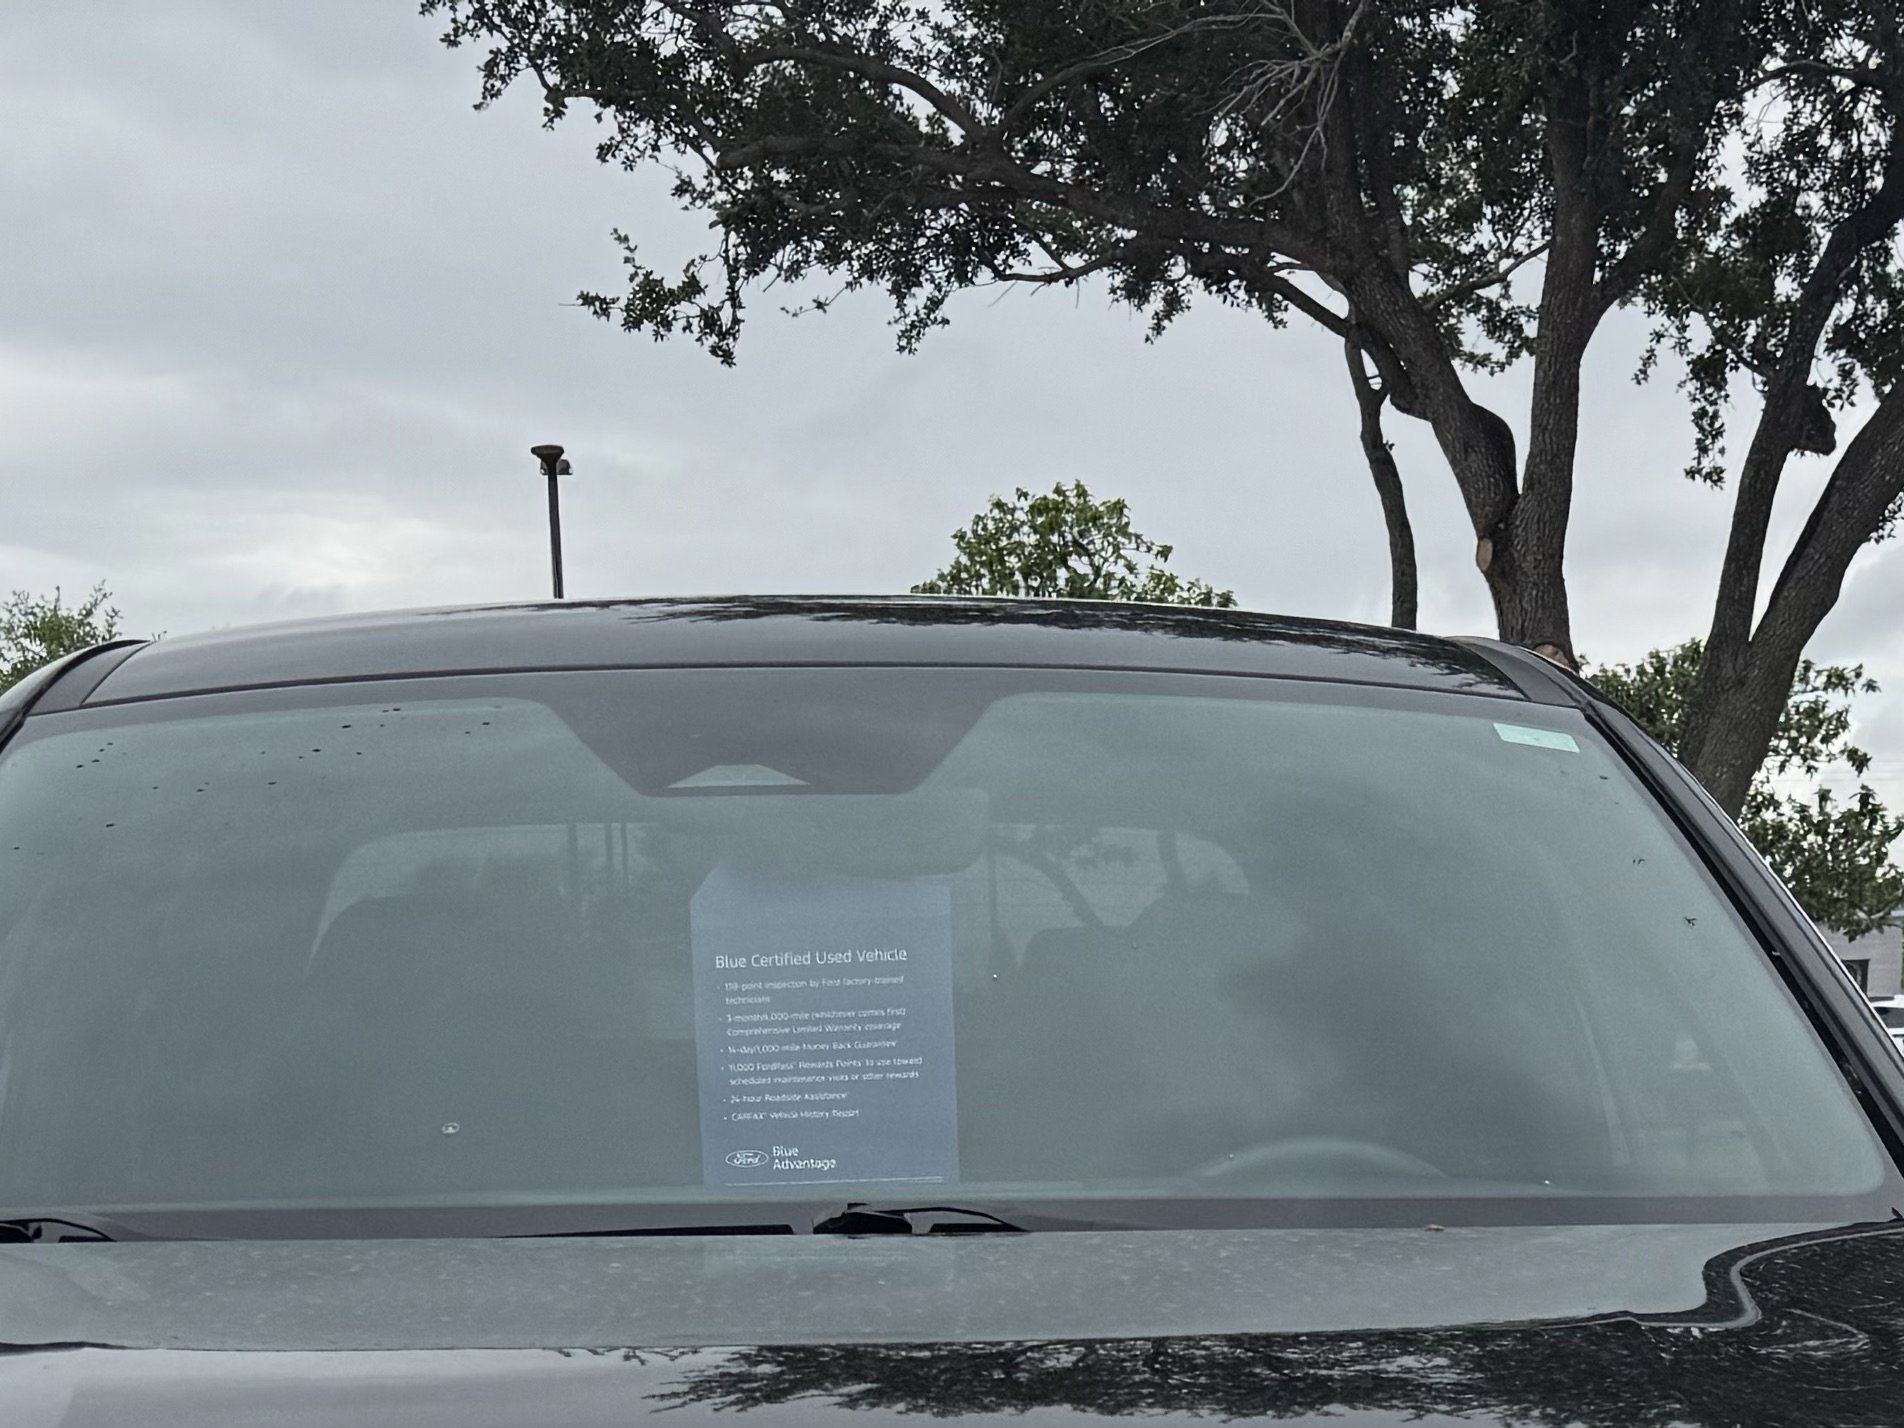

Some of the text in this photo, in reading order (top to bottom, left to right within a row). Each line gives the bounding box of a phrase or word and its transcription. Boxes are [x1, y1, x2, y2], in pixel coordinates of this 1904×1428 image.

[716, 948, 907, 969] Blue Certified Used Vehicle
[772, 1145, 799, 1157] Blue
[773, 1159, 837, 1171] Advantage
